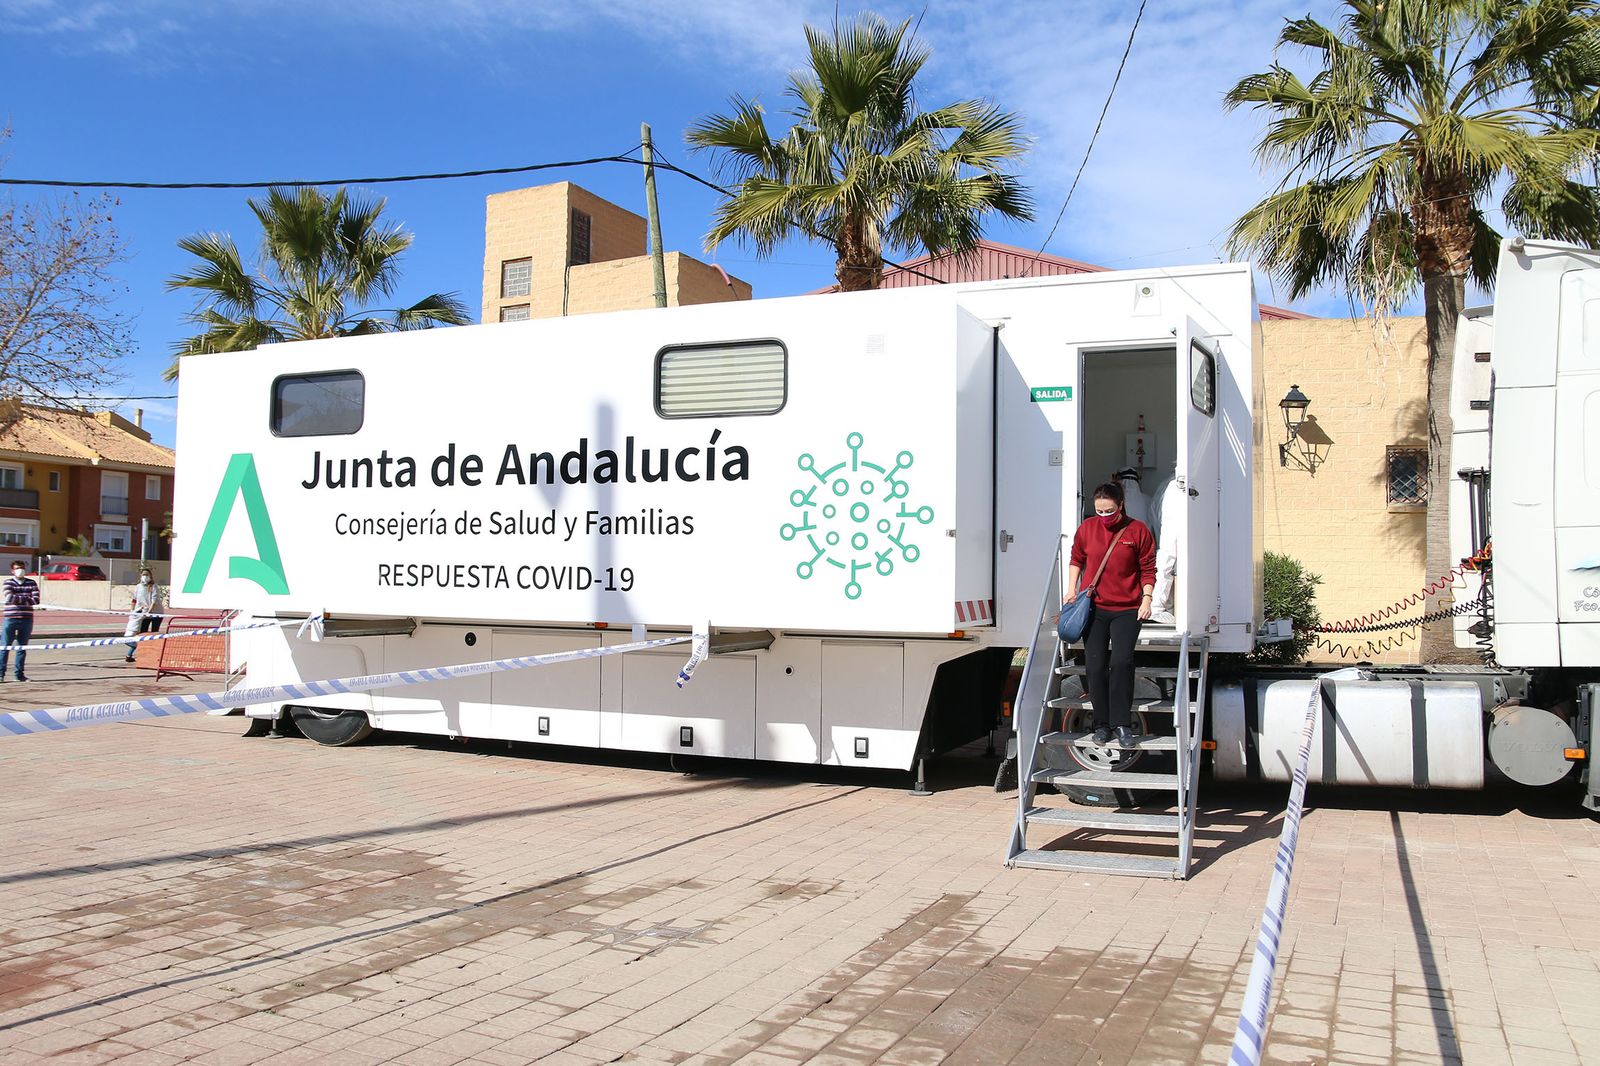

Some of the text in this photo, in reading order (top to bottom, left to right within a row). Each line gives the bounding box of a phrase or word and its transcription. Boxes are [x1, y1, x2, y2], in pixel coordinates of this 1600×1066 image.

[1035, 390, 1067, 398] SALIDA
[301, 428, 749, 490] Junta de Andalucía
[335, 508, 695, 542] Consejería de Salud y Familias
[378, 564, 634, 592] RESPUESTA COVID-19
